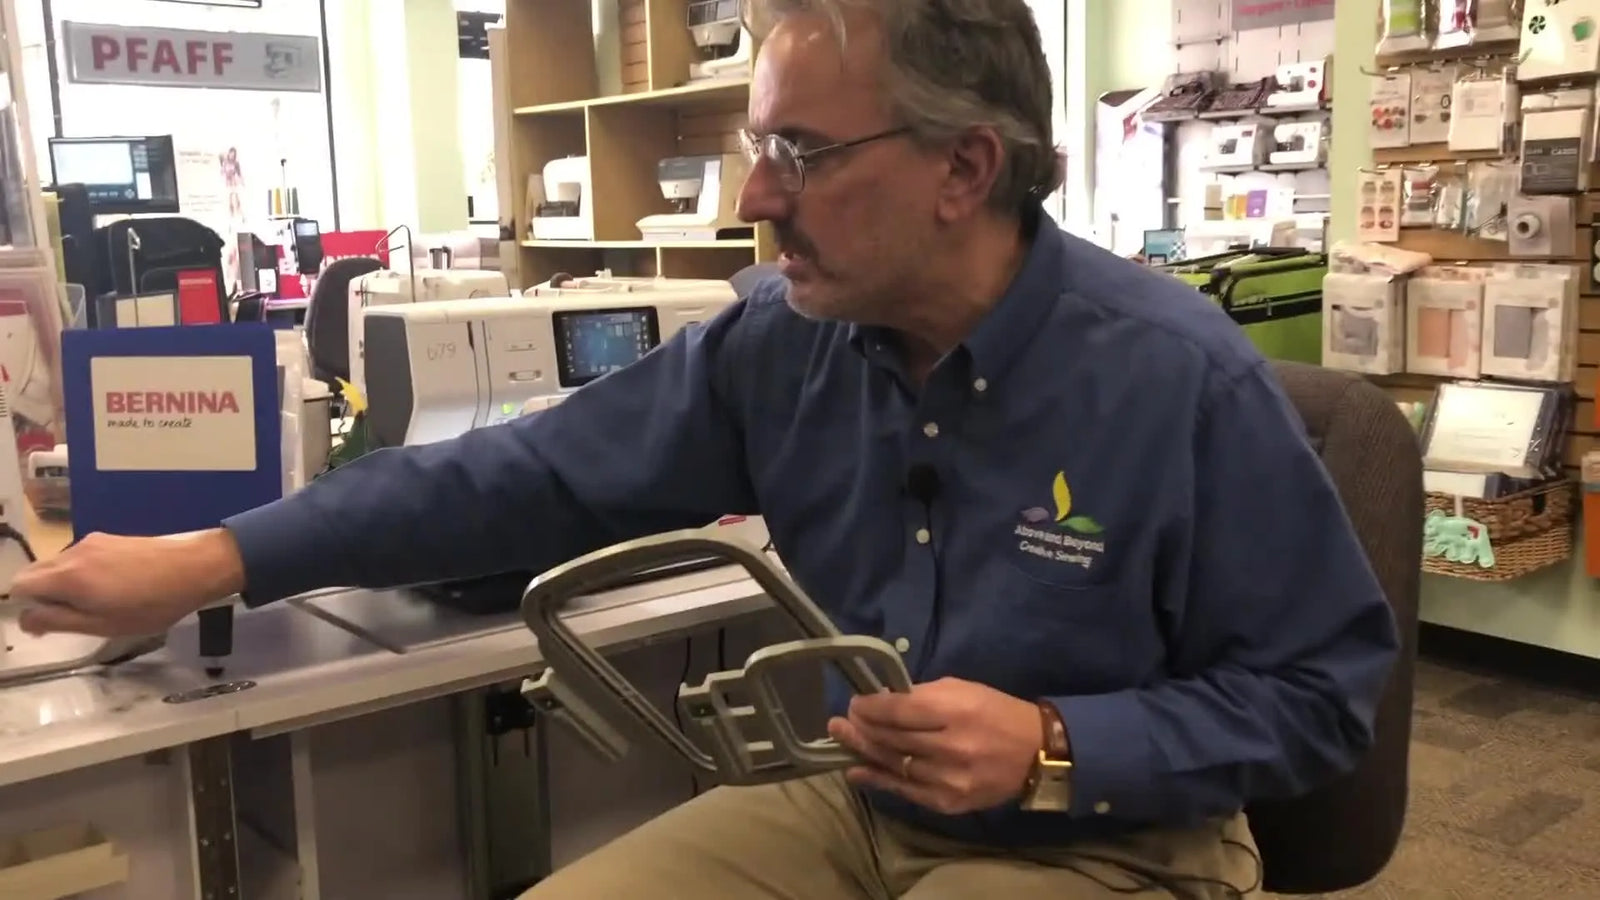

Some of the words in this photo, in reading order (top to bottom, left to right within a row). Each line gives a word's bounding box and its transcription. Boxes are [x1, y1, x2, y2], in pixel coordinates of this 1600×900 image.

[91, 35, 233, 76] PFAFF
[106, 391, 240, 414] BERNINA
[107, 417, 140, 429] made
[143, 417, 155, 429] to
[158, 416, 193, 429] create
[1063, 534, 1105, 554] Beyond
